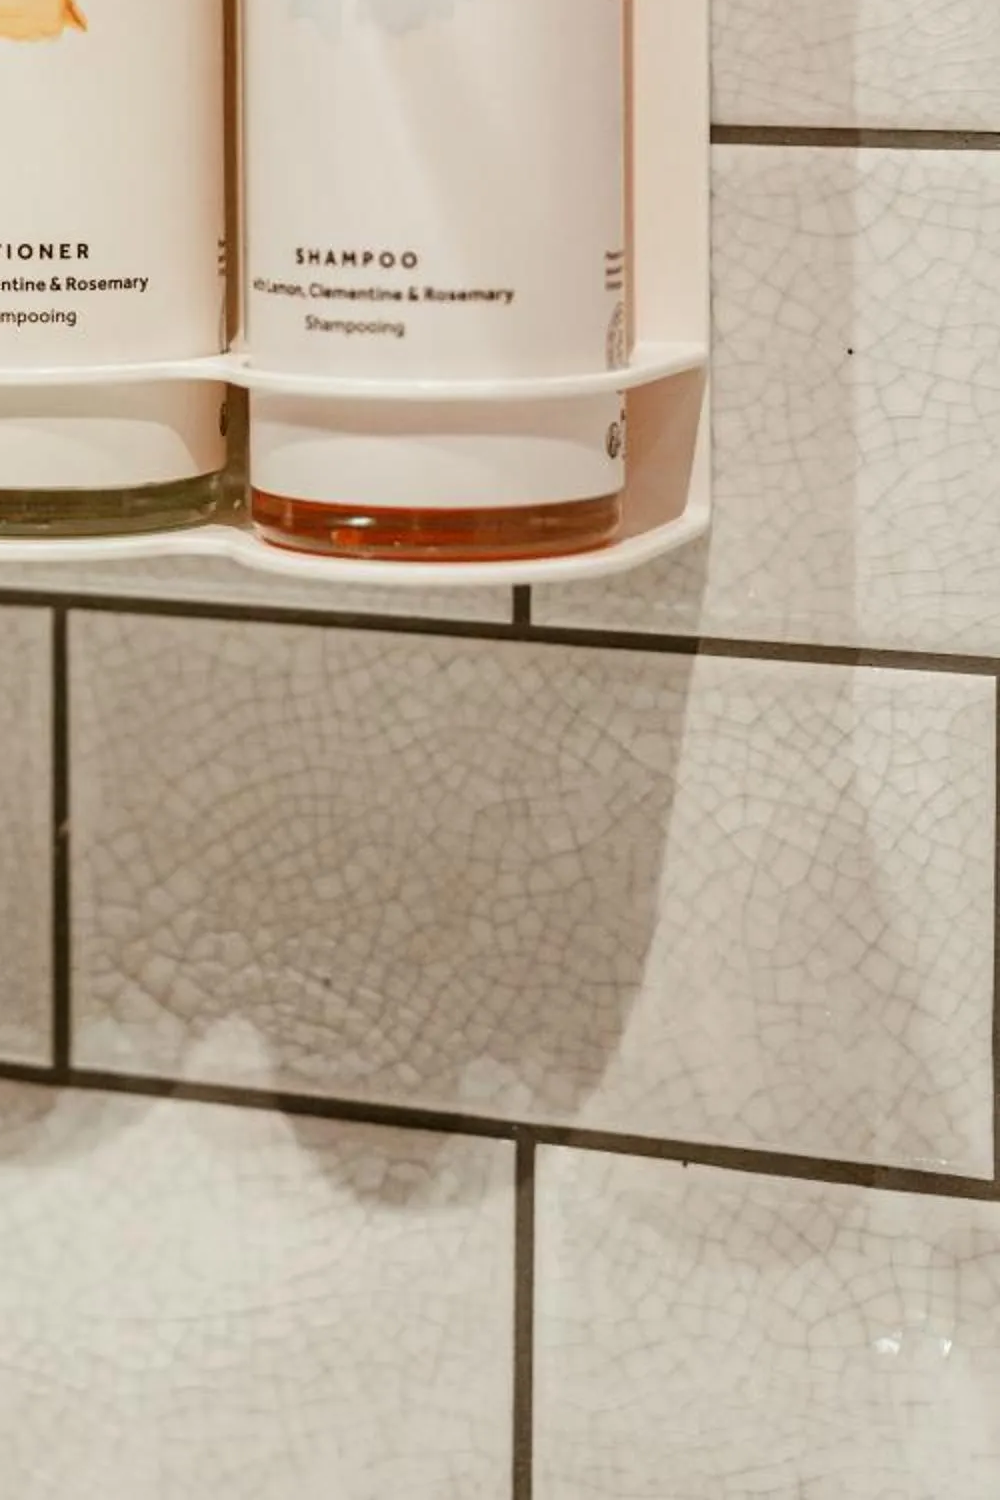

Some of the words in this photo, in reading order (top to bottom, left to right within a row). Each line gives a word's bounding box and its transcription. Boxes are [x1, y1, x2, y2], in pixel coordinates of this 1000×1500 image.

[296, 247, 418, 269] SHAMPOO
[49, 276, 62, 292] &
[66, 276, 149, 293] Rosemary
[309, 282, 403, 301] Clementine
[408, 285, 419, 301] &
[424, 286, 515, 304] Rosemary
[305, 314, 405, 338] Shampooing
